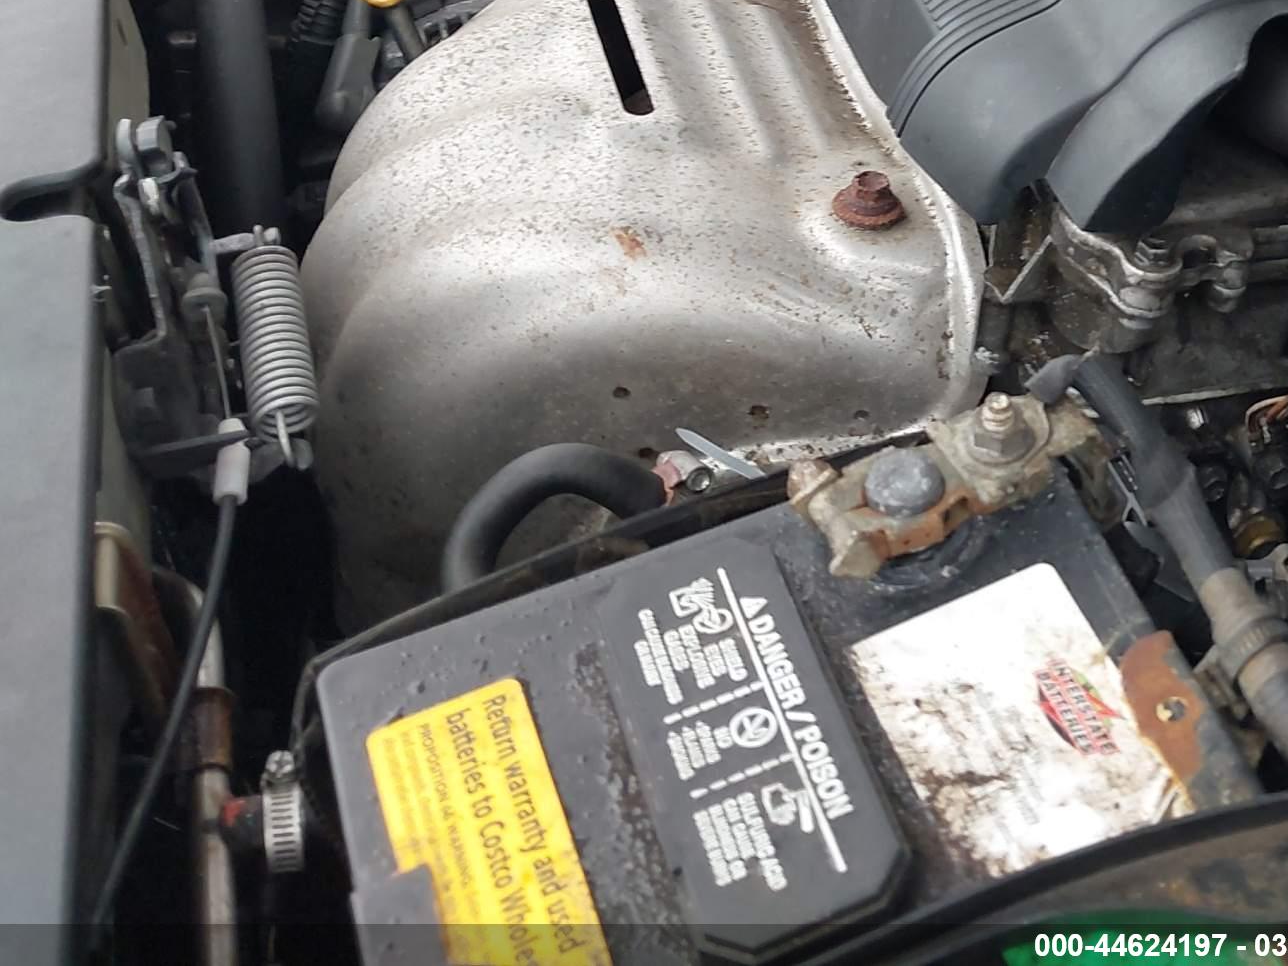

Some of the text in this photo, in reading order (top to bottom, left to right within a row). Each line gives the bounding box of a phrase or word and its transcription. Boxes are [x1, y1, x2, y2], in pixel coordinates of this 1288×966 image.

[445, 707, 486, 794] batteries
[472, 795, 493, 819] to
[482, 694, 586, 954] Return warranty and used
[479, 820, 513, 889] Costco
